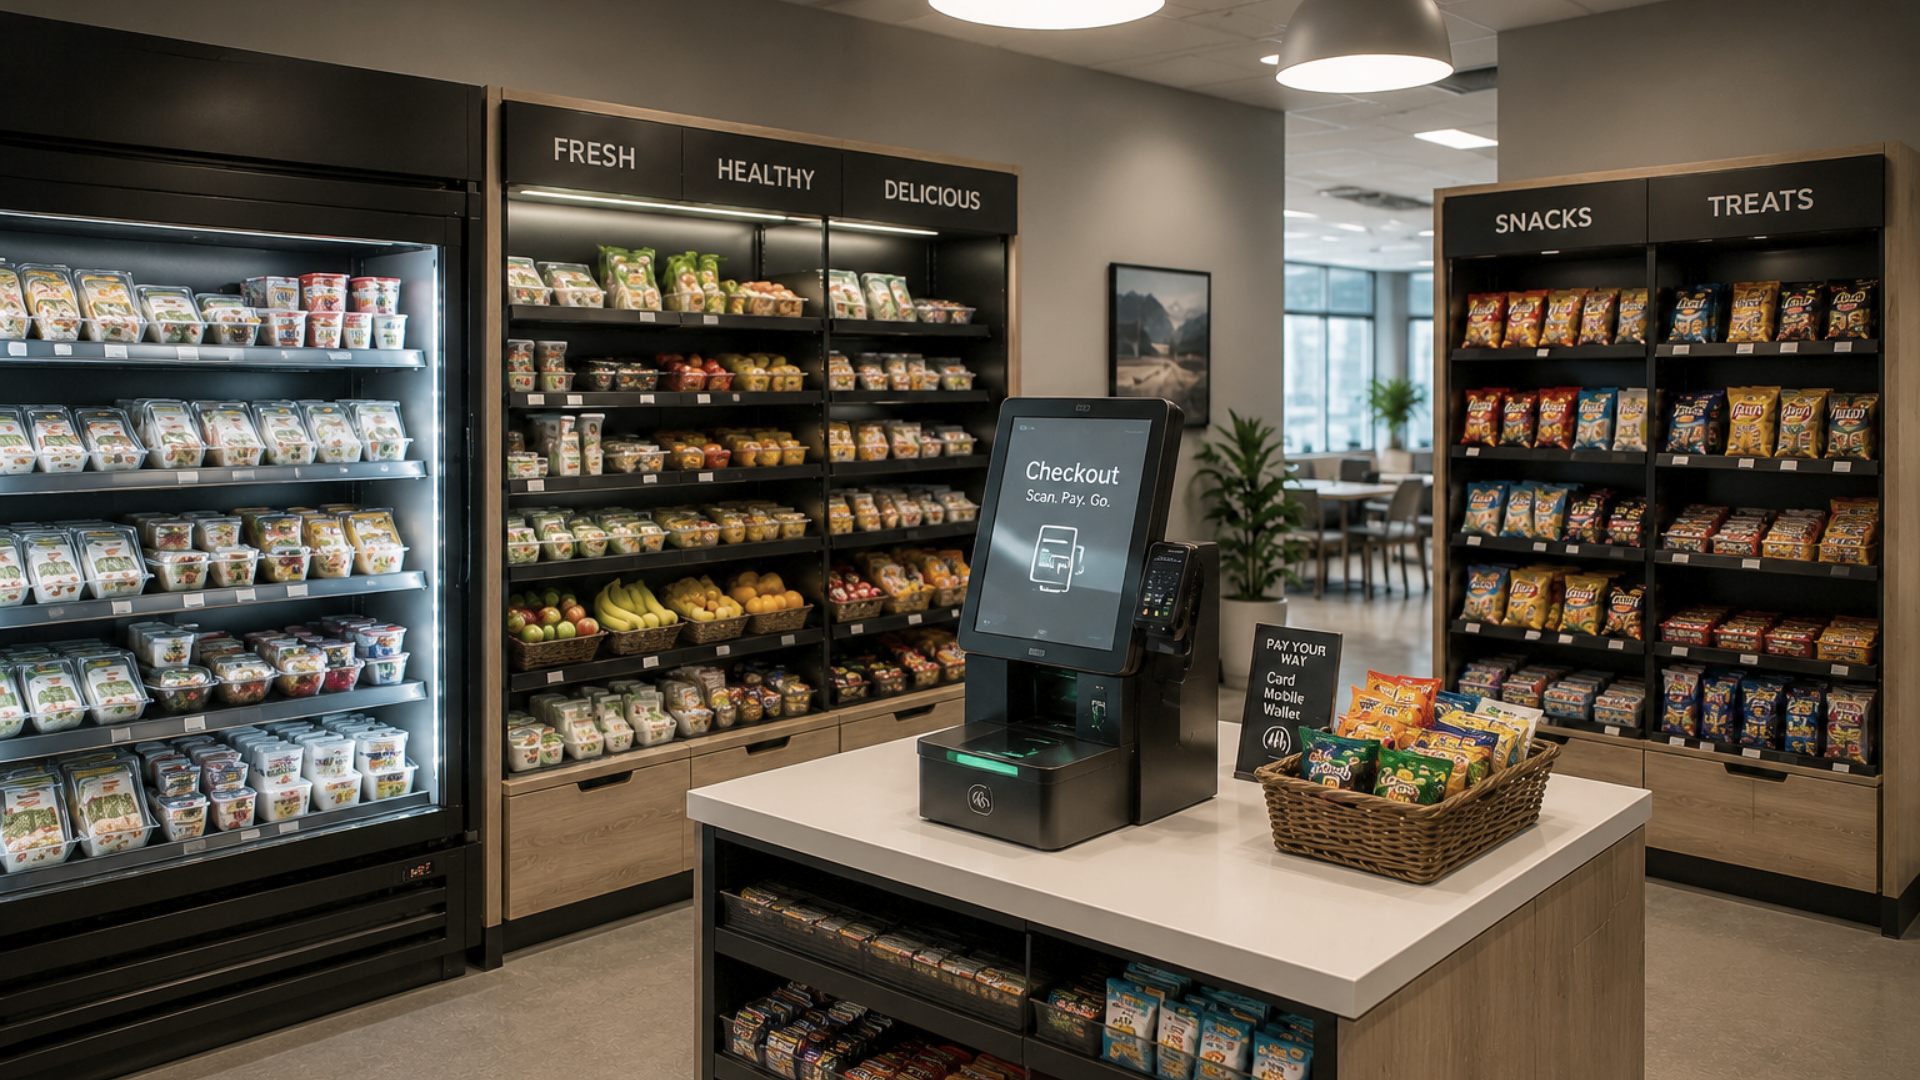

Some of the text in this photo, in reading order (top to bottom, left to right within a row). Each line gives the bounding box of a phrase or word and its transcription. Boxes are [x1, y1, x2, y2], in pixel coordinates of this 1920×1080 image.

[554, 137, 635, 170] FRESH
[718, 158, 815, 190] HEALTHY
[885, 179, 981, 210] DELICIOUS
[1707, 188, 1814, 217] TREATS
[1495, 206, 1592, 234] SNACKS
[1025, 460, 1120, 485] Checkout
[1025, 488, 1111, 508] Scan. Pay. Go.
[1266, 638, 1327, 657] PAY YOUR
[1281, 653, 1308, 667] WAY
[1266, 671, 1296, 687] Card
[1263, 687, 1305, 705] Mobile
[1263, 702, 1301, 721] Wallet
